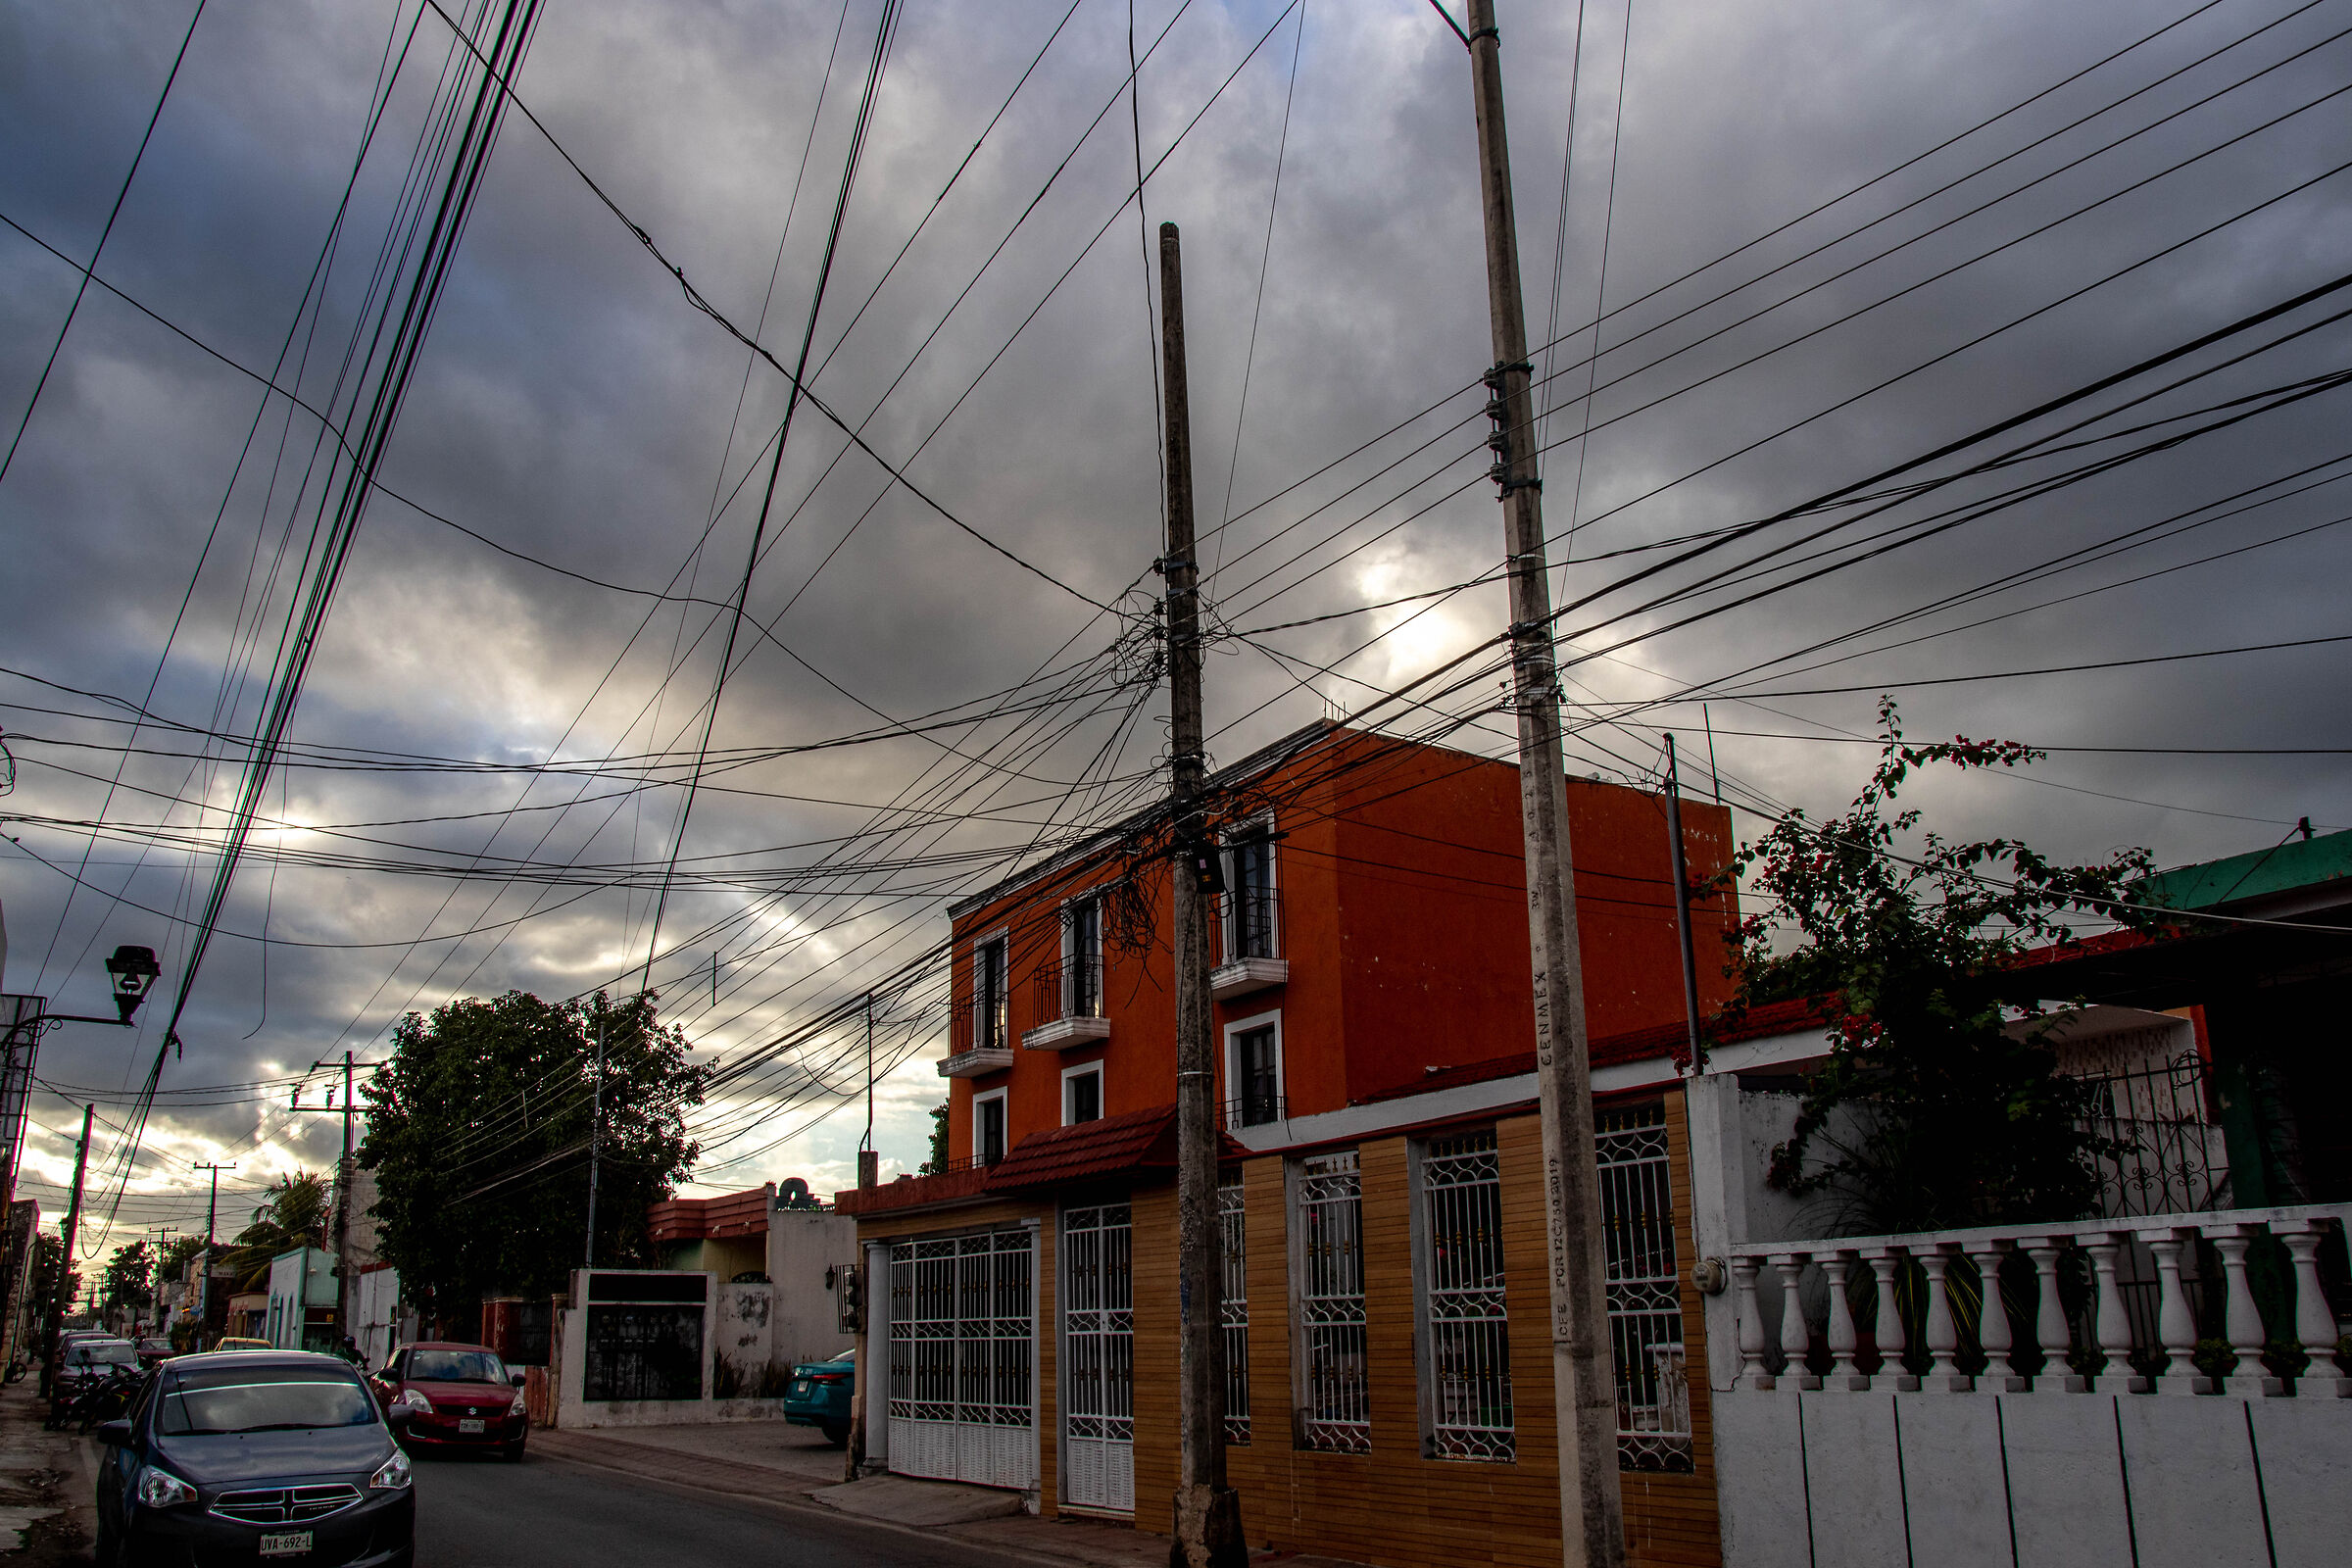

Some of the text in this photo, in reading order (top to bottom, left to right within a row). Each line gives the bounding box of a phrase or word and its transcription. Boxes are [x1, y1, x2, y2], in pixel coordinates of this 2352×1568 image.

[1534, 971, 1551, 1066] CENMEX
[1557, 1304, 1568, 1336] CFE
[261, 1535, 312, 1550] UVA-692-L
